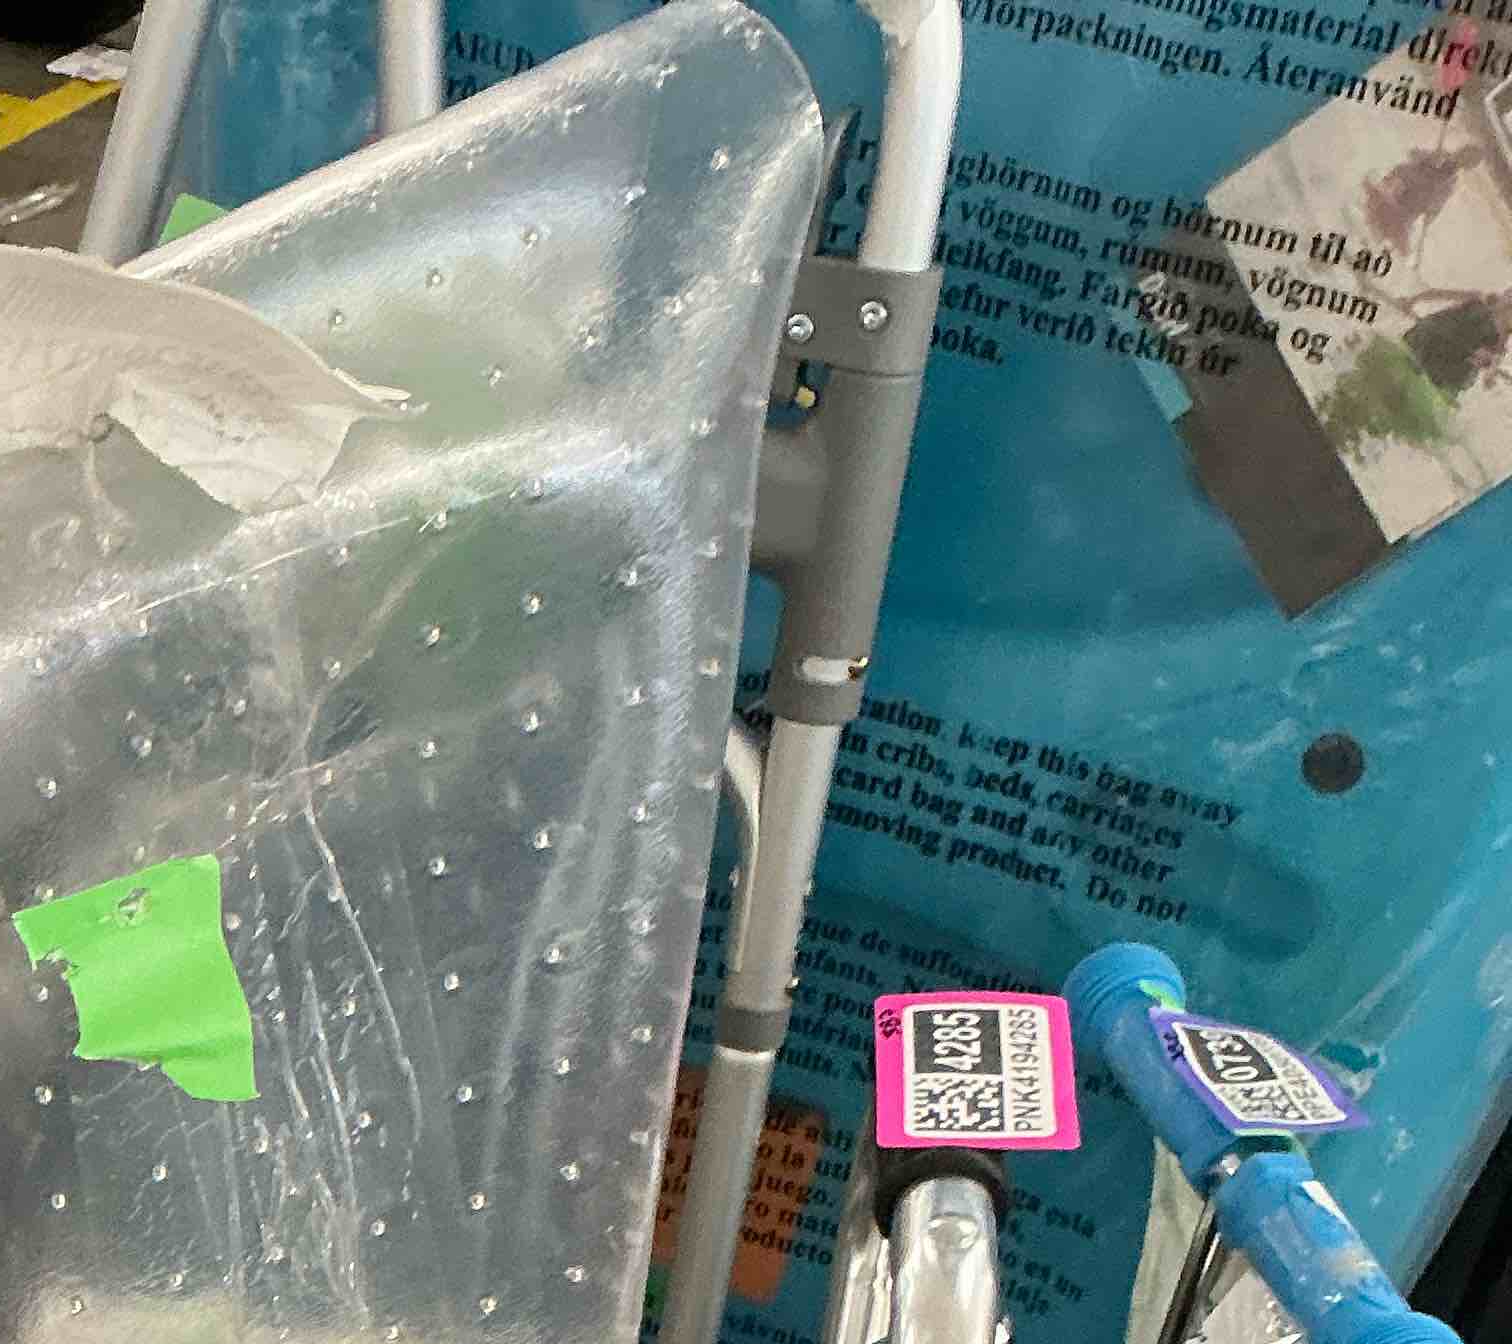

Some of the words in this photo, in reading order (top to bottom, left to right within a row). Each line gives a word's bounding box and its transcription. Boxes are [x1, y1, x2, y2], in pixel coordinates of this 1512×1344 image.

[1244, 42, 1461, 119] Återanvänd
[1111, 195, 1155, 230] og
[1308, 231, 1347, 266] til
[939, 281, 1011, 319] efur
[1249, 265, 1379, 324] vögnum
[1290, 327, 1334, 366] og
[958, 721, 1031, 767] kep
[931, 1009, 983, 1072] 4285
[1008, 1006, 1044, 1133] PNK4194285
